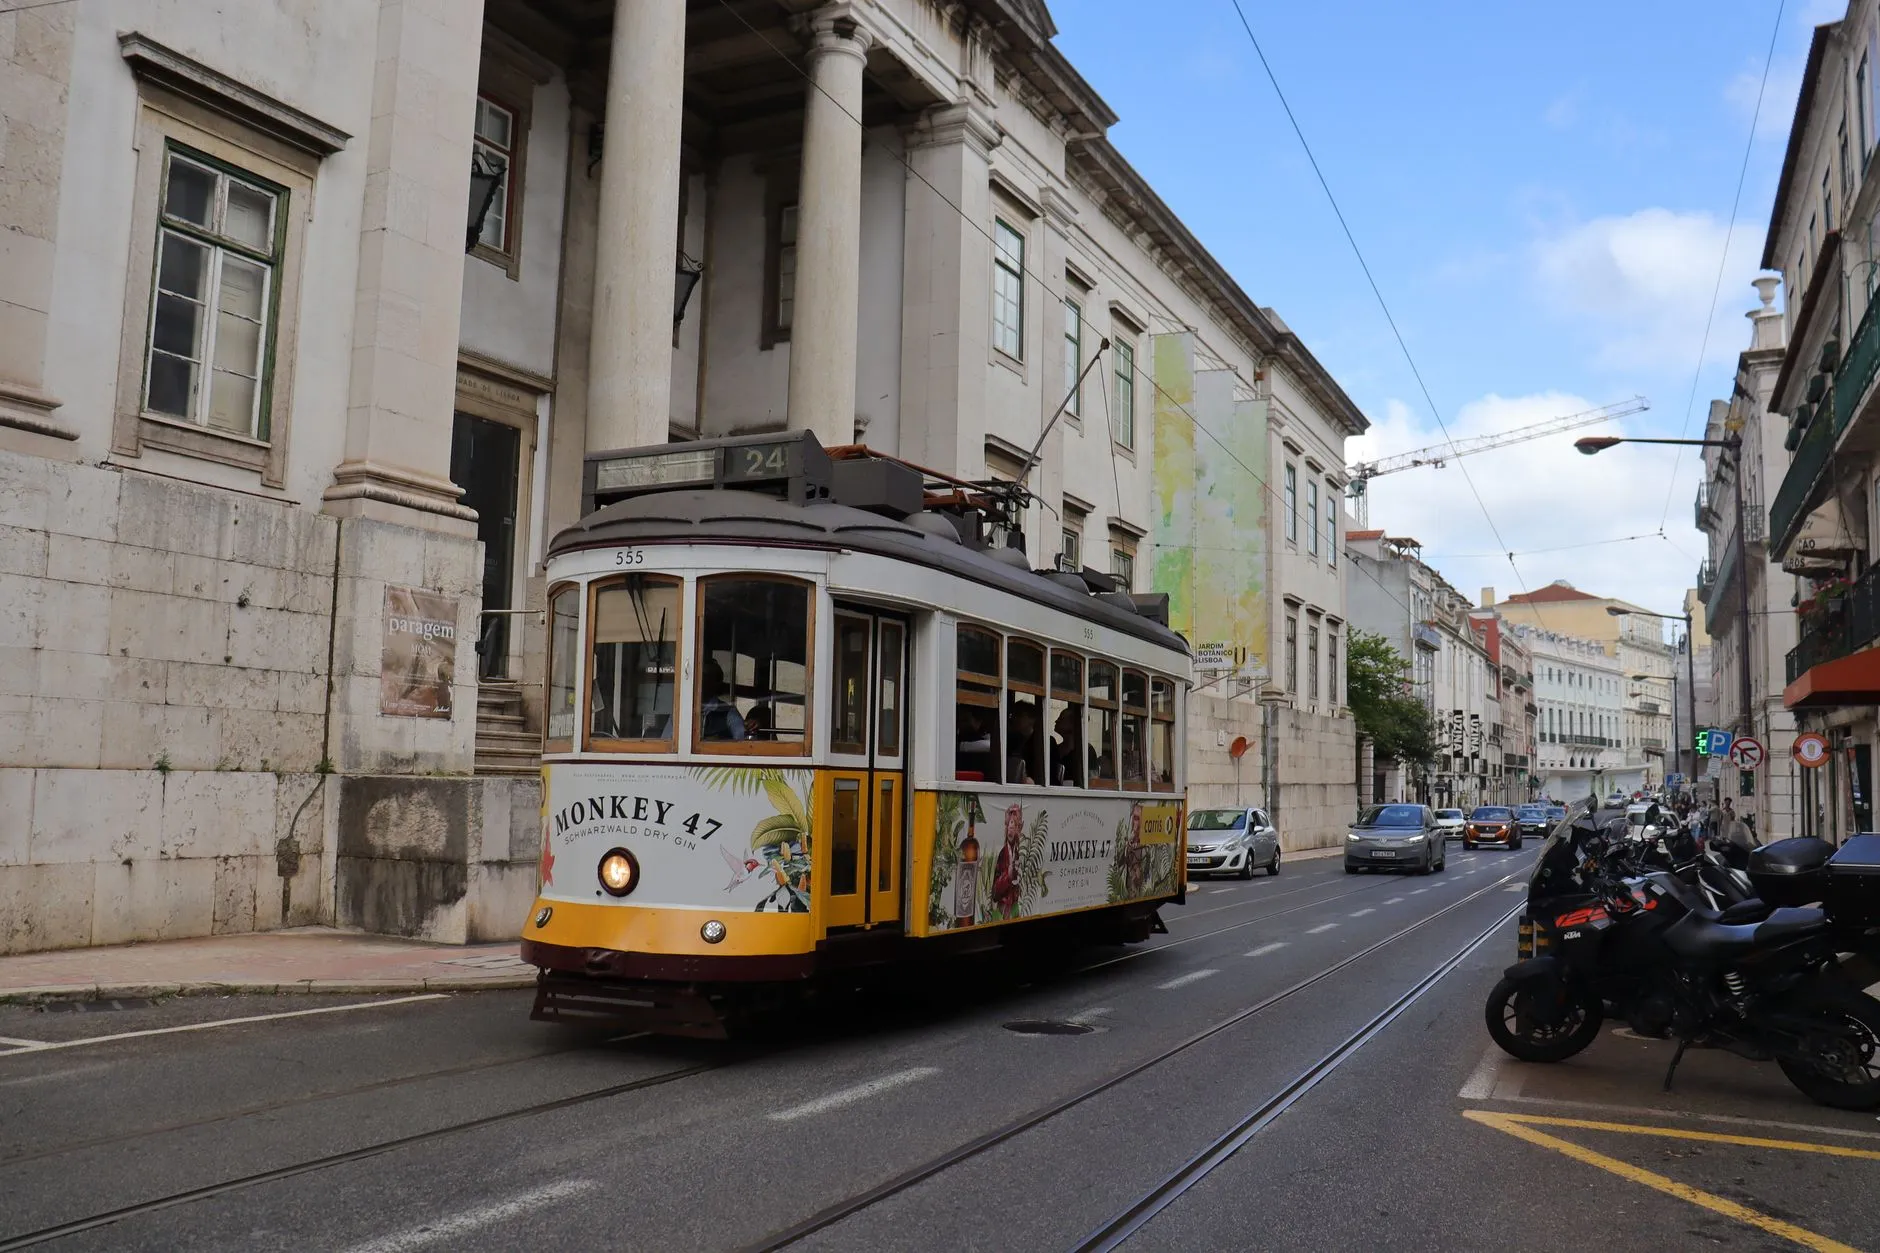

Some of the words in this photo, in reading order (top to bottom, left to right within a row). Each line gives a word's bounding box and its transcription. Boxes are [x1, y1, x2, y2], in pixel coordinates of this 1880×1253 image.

[745, 446, 785, 477] 24
[615, 550, 644, 566] 555
[388, 617, 455, 641] paragem
[1084, 628, 1093, 639] 555
[1198, 649, 1233, 657] BOTÂNICO
[1454, 715, 1463, 751] UZINA
[1471, 719, 1479, 752] UZINA
[1711, 733, 1726, 751] P
[554, 795, 675, 837] MONKEY
[682, 812, 723, 841] 47
[1144, 814, 1163, 833] carris
[564, 824, 638, 845] SCHWARZWALD
[643, 828, 669, 841] DRY
[674, 836, 698, 851] GIN
[1049, 840, 1099, 862] MONKEY
[1099, 839, 1112, 858] 47
[1059, 865, 1099, 877] SCHWARZWALD
[1563, 931, 1581, 940] KTM
